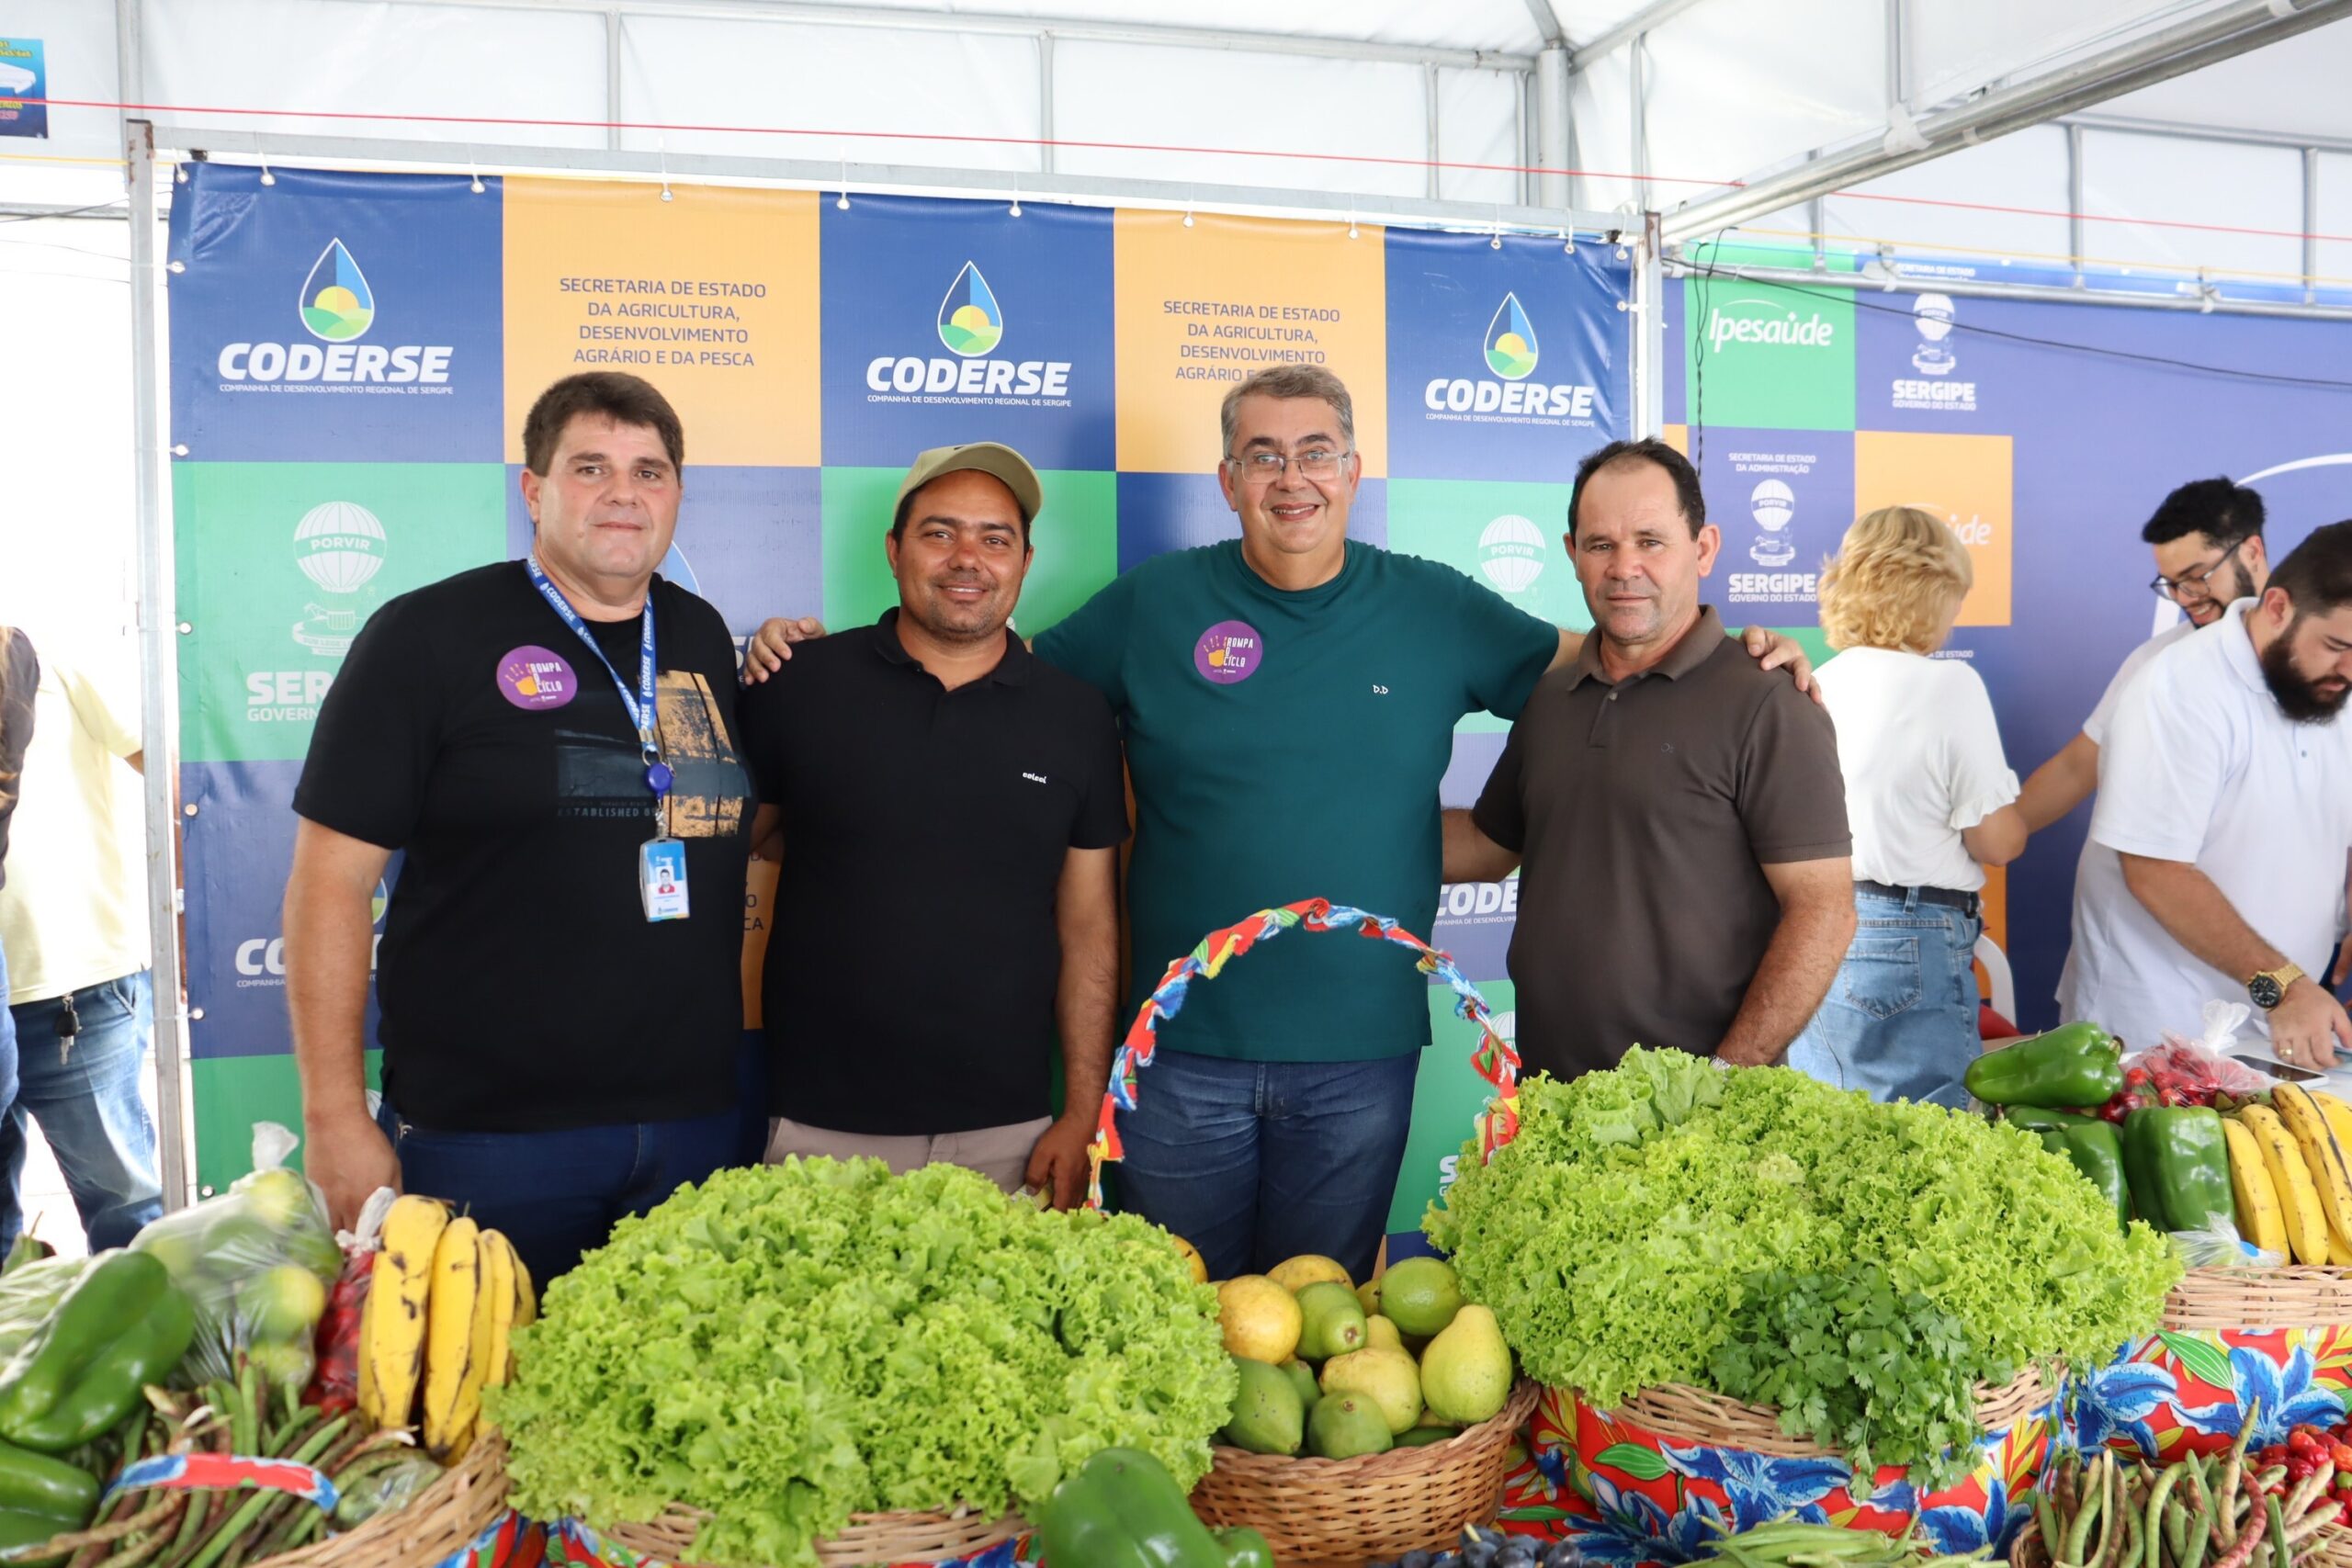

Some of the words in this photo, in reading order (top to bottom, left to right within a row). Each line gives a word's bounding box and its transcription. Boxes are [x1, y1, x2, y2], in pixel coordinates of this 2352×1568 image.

[559, 277, 666, 295] SECRETARIA
[671, 281, 694, 295] DE
[698, 282, 766, 298] ESTADO
[587, 302, 612, 316] DA
[616, 303, 740, 322] AGRICULTURA,
[1163, 300, 1255, 318] SECRETARIA
[1259, 306, 1278, 319] DE
[1283, 307, 1340, 322] ESTADO
[579, 325, 749, 344] DESENVOLVIMENTO
[1188, 323, 1209, 337] DA
[1213, 324, 1318, 344] AGRICULTURA,
[1708, 308, 1833, 354] Ipesaúde
[218, 342, 454, 383] CODERSE
[573, 347, 651, 364] AGRÁRIO
[656, 350, 666, 364] E
[671, 351, 695, 365] DA
[699, 352, 755, 367] PESCA
[1180, 344, 1325, 364] DESENVOLVIMENTO
[866, 356, 1072, 397] CODERSE
[1175, 365, 1242, 381] AGRÁRIO
[220, 384, 270, 392] COMPANHIA
[283, 385, 365, 394] DESENVOLVIMENTO
[365, 386, 405, 395] REGIONAL
[419, 387, 455, 395] SERGIPE
[1425, 378, 1596, 417] CODERSE
[1892, 379, 1976, 401] SERGIPE
[866, 394, 911, 403] COMPANHIA
[923, 396, 994, 405] DESENVOLVIMENTO
[994, 398, 1031, 406] REGIONAL
[1042, 399, 1072, 408] SERGIPE
[1425, 412, 1463, 422] COMPANHIA
[1463, 414, 1472, 423] DE
[1472, 415, 1531, 424] DESENVOLVIMENTO
[1531, 418, 1562, 426] REGIONAL
[1728, 452, 1774, 462] SECRETARIA
[1774, 454, 1786, 463] DE
[1786, 454, 1816, 464] ESTADO
[1736, 463, 1747, 472] DA
[311, 536, 372, 551] PORVIR
[1491, 545, 1534, 558] PORVIR
[1728, 572, 1816, 593] SERGIPE
[547, 587, 577, 622] CODERSE
[1728, 593, 1770, 603] GOVERNO
[1770, 593, 1783, 603] DO
[1783, 593, 1817, 603] ESTADO
[642, 654, 652, 691] CODERSE
[1373, 684, 1389, 695] D.D
[247, 706, 318, 722] GOVERN
